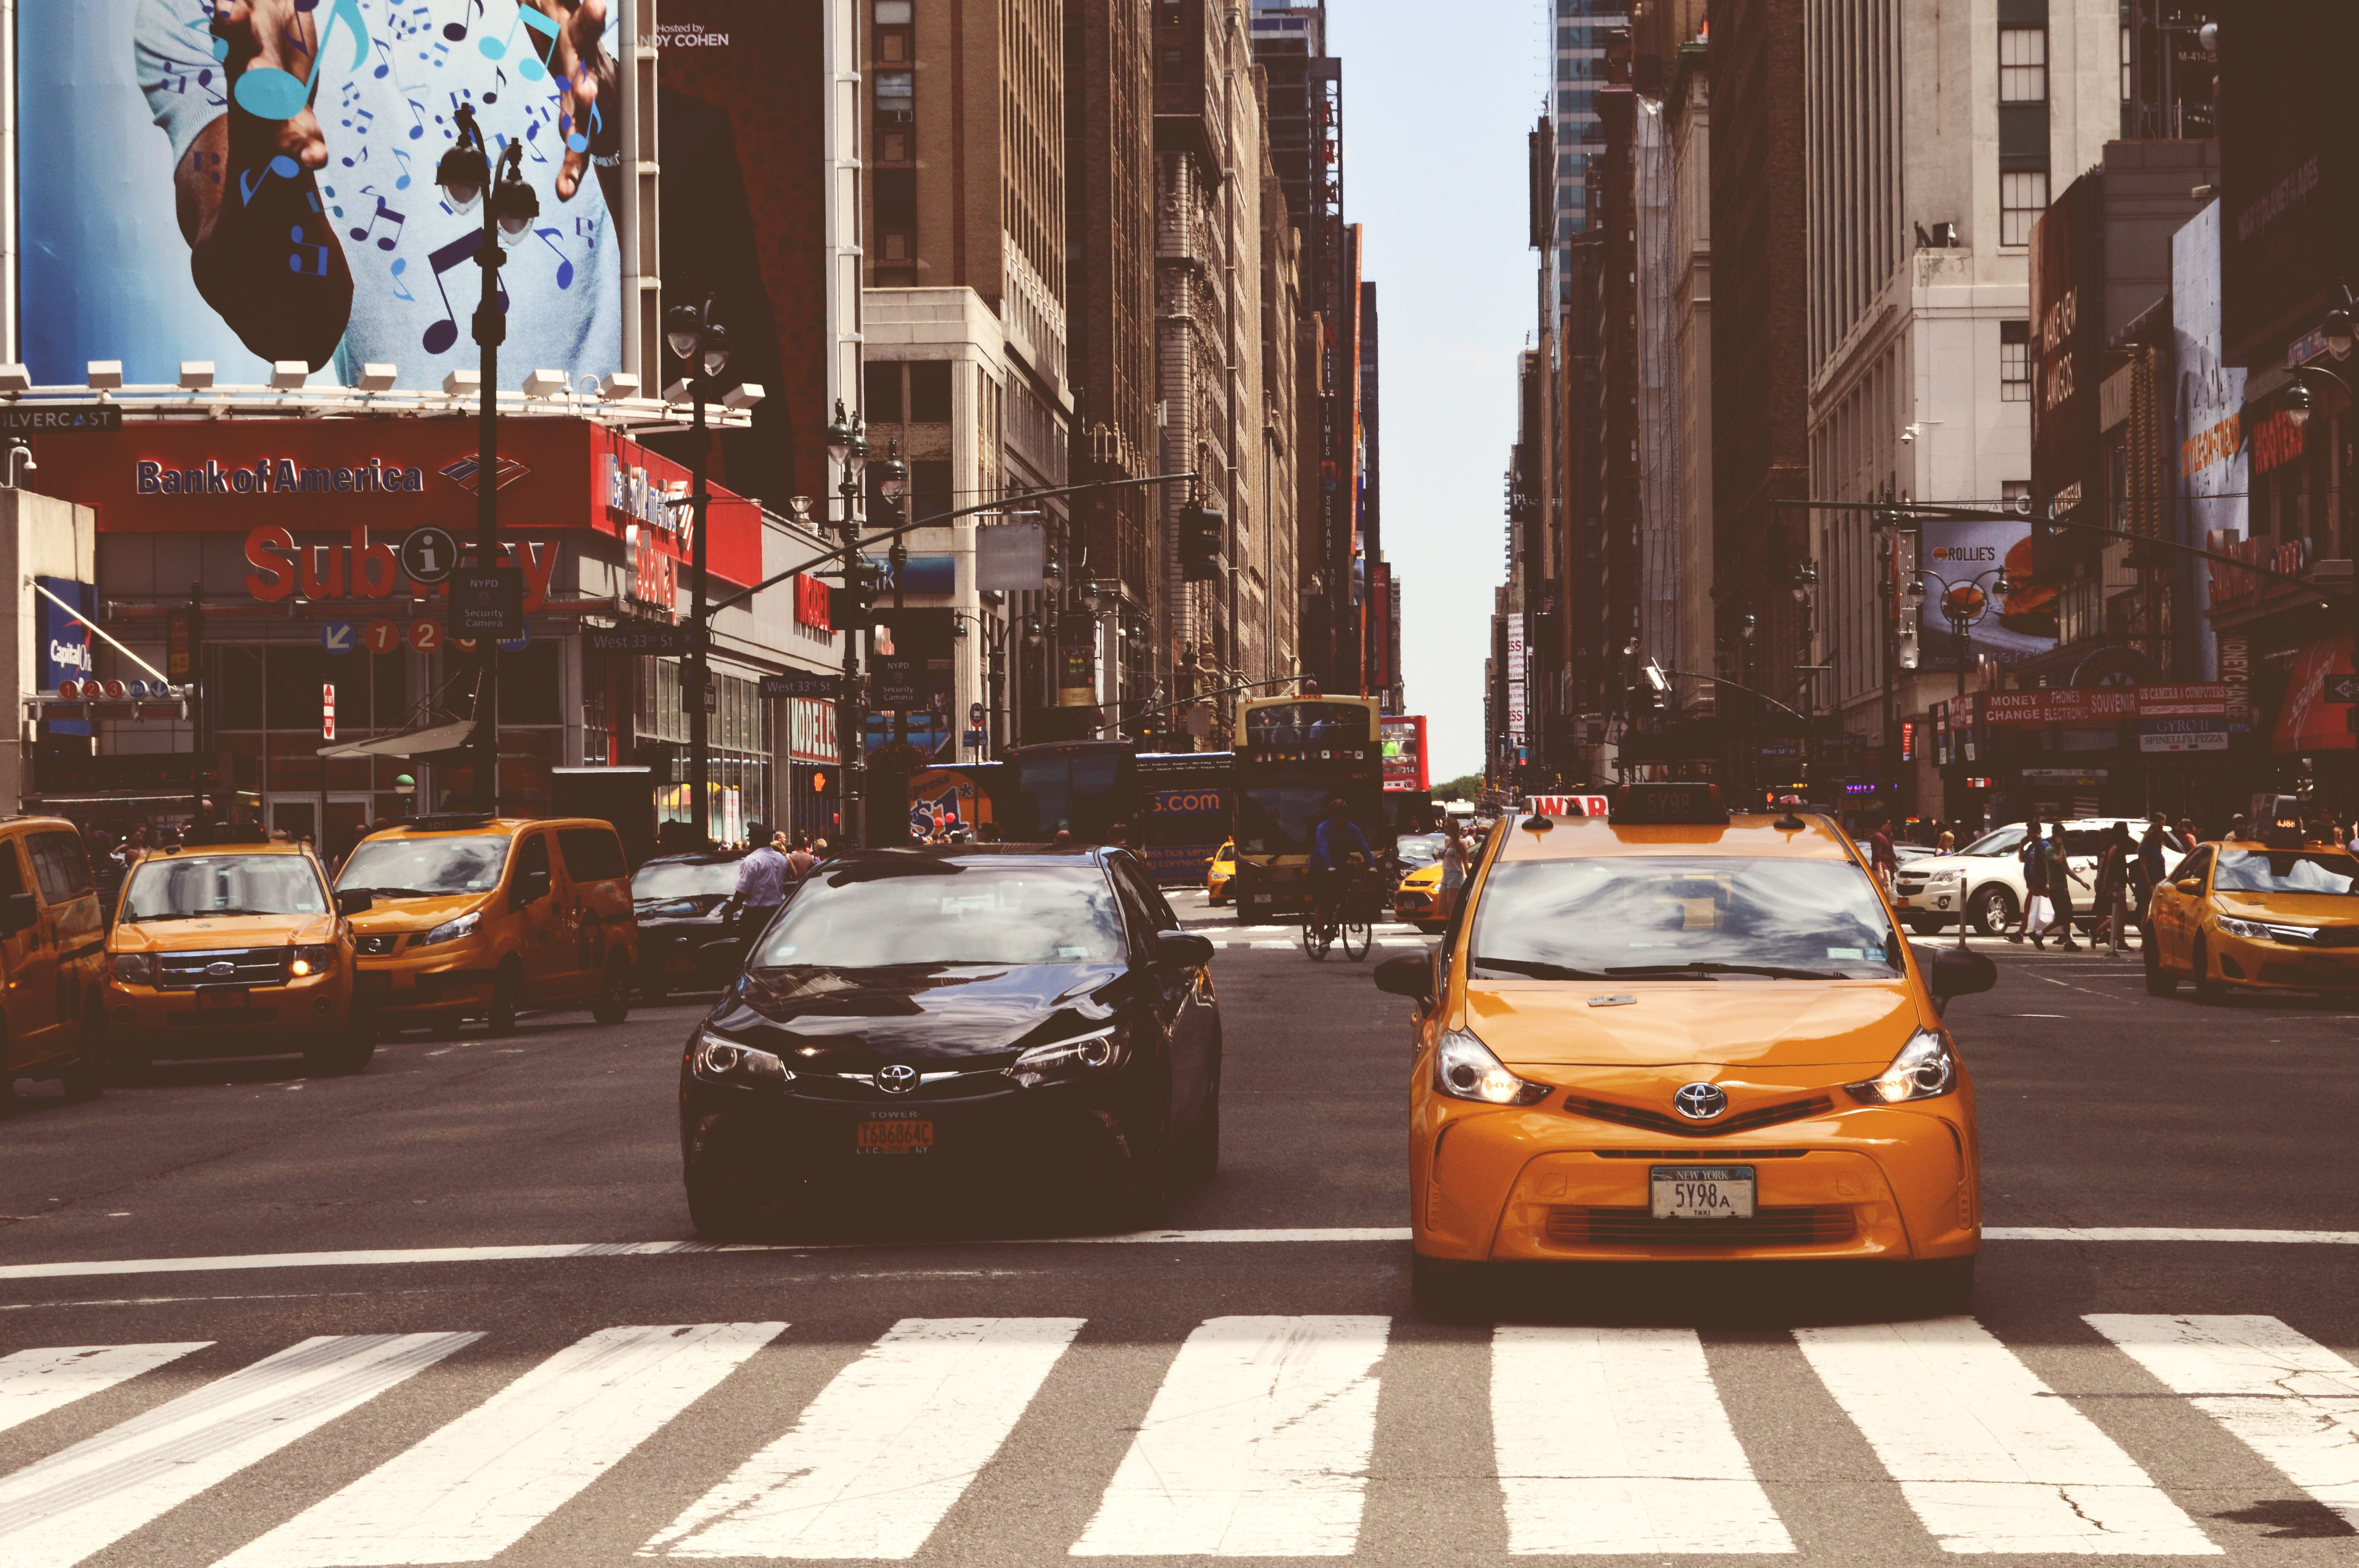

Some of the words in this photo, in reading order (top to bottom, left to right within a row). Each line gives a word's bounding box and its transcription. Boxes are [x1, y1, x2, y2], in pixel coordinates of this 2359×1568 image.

[657, 25, 689, 33] Hosted
[692, 23, 705, 34] by
[638, 35, 671, 47] NDY
[674, 34, 729, 47] COHEN
[2043, 302, 2060, 356] MAKE
[2061, 286, 2077, 341] NEW
[273, 458, 424, 492] America
[1949, 547, 1995, 561] ROLLIE'S
[245, 524, 559, 613] Suby
[470, 579, 498, 588] NYPD
[464, 609, 504, 618] Security
[418, 624, 435, 647] 2
[594, 635, 627, 648] West
[632, 635, 656, 647] 33rd
[661, 635, 674, 647] St
[64, 684, 70, 693] 1
[87, 683, 95, 692] 2
[110, 682, 117, 692] 3
[767, 681, 794, 692] West
[798, 681, 817, 692] 33rd
[820, 681, 831, 691] St
[883, 685, 914, 694] Security
[2139, 688, 2148, 700] US
[2151, 687, 2178, 699] CAMERA
[2185, 685, 2225, 698] COMPUTERS
[1991, 695, 2037, 706] MONEY
[2051, 690, 2080, 704] PHONES
[2092, 693, 2136, 714] SOUVENIR
[2223, 675, 2248, 719] CHANGE
[1986, 709, 2040, 721] CHANGE
[2044, 706, 2088, 721] ELECTRONIC
[791, 697, 838, 758] MODELL'S
[2157, 720, 2195, 732] GYRO
[2145, 736, 2192, 744] SPINELLI'S
[2195, 735, 2223, 743] PIZZA
[1534, 797, 1607, 816] WAR
[1647, 793, 1690, 815] 5Y98
[2276, 819, 2295, 828] 4J88
[862, 1124, 929, 1144] T686864C
[1677, 1171, 1699, 1180] NEW
[1702, 1171, 1728, 1180] YORK
[1675, 1183, 1730, 1208] 5Y98A
